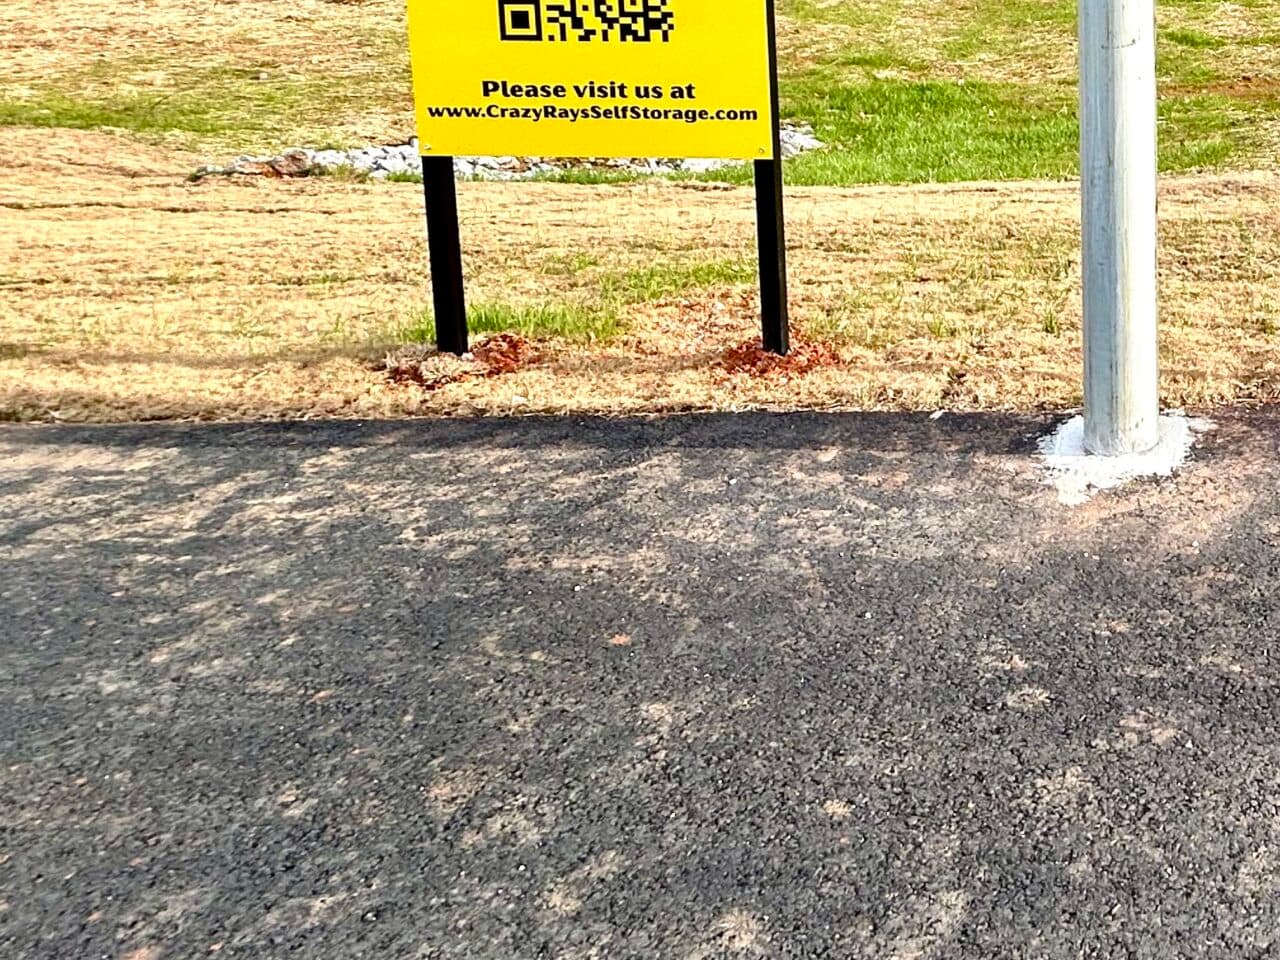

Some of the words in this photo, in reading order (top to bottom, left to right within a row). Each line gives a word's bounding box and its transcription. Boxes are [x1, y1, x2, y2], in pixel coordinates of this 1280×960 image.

[482, 80, 566, 98] Please
[573, 81, 628, 99] visit
[635, 84, 663, 99] us
[670, 83, 696, 99] at
[427, 104, 758, 122] www.CrazyRaysSelfStorage.com
